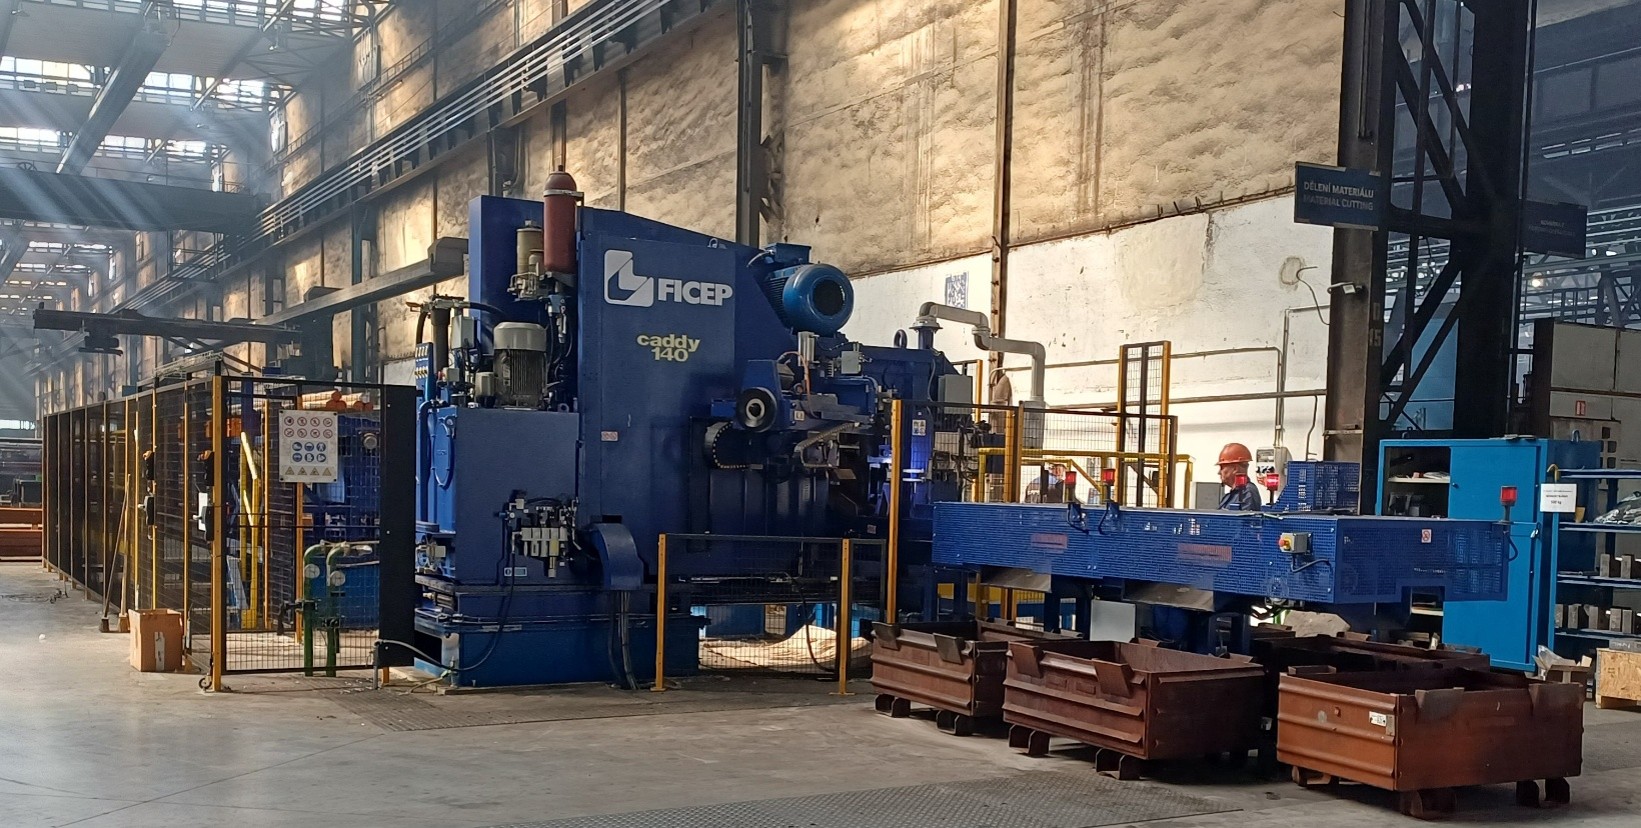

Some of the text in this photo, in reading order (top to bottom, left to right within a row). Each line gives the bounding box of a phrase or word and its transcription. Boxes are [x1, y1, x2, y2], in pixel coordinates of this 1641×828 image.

[1332, 185, 1374, 198] MATERIÁLU
[1303, 194, 1374, 211] MATERIAL CUTTING
[658, 278, 733, 306] FICEP
[636, 333, 701, 352] caddy
[651, 347, 689, 362] 140
